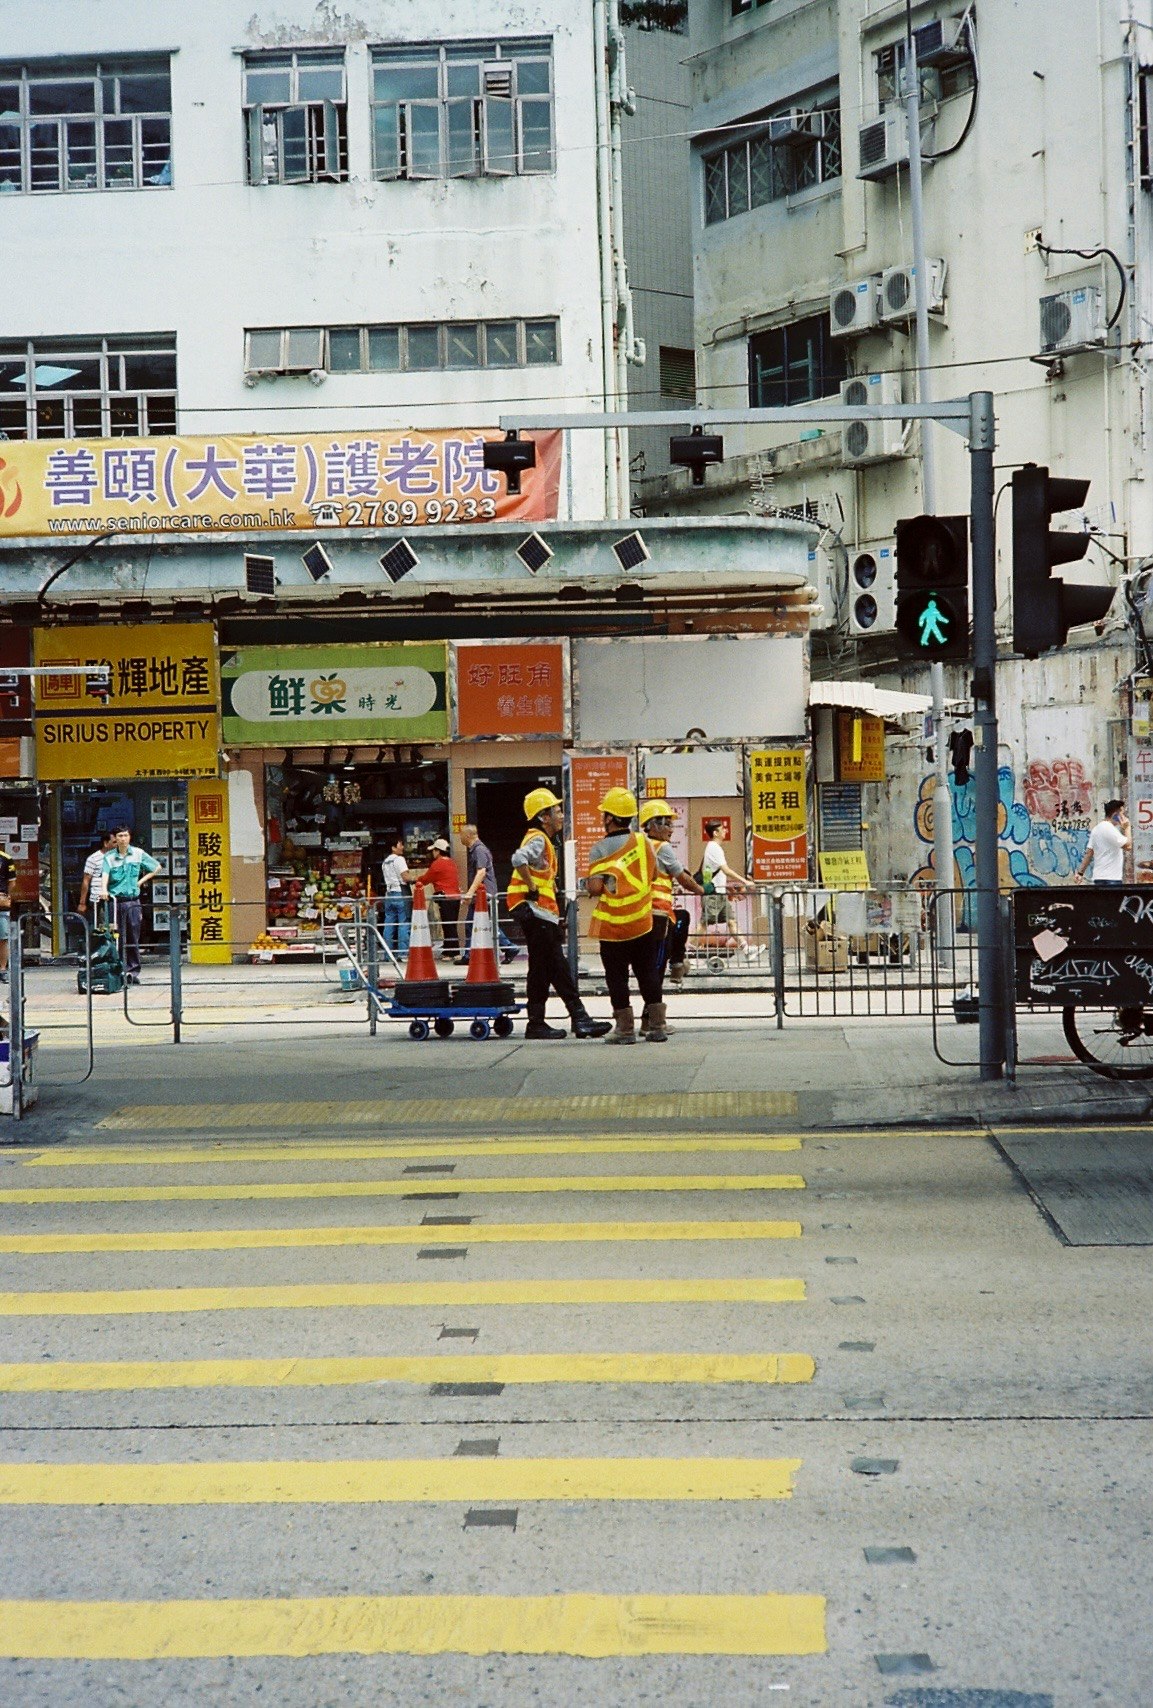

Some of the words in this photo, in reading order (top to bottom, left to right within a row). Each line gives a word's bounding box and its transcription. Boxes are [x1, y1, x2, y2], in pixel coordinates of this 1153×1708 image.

[45, 437, 498, 507] 善頤(大華)護老院
[48, 509, 296, 532] www.seniorcare.com.hk
[347, 500, 418, 526] 2789
[425, 498, 497, 524] 9233
[358, 693, 402, 712] 時光
[43, 723, 109, 744] SIRIUS
[114, 720, 209, 742] PROPERTY
[758, 791, 800, 809] 招租
[197, 833, 224, 941] 駿輝地產
